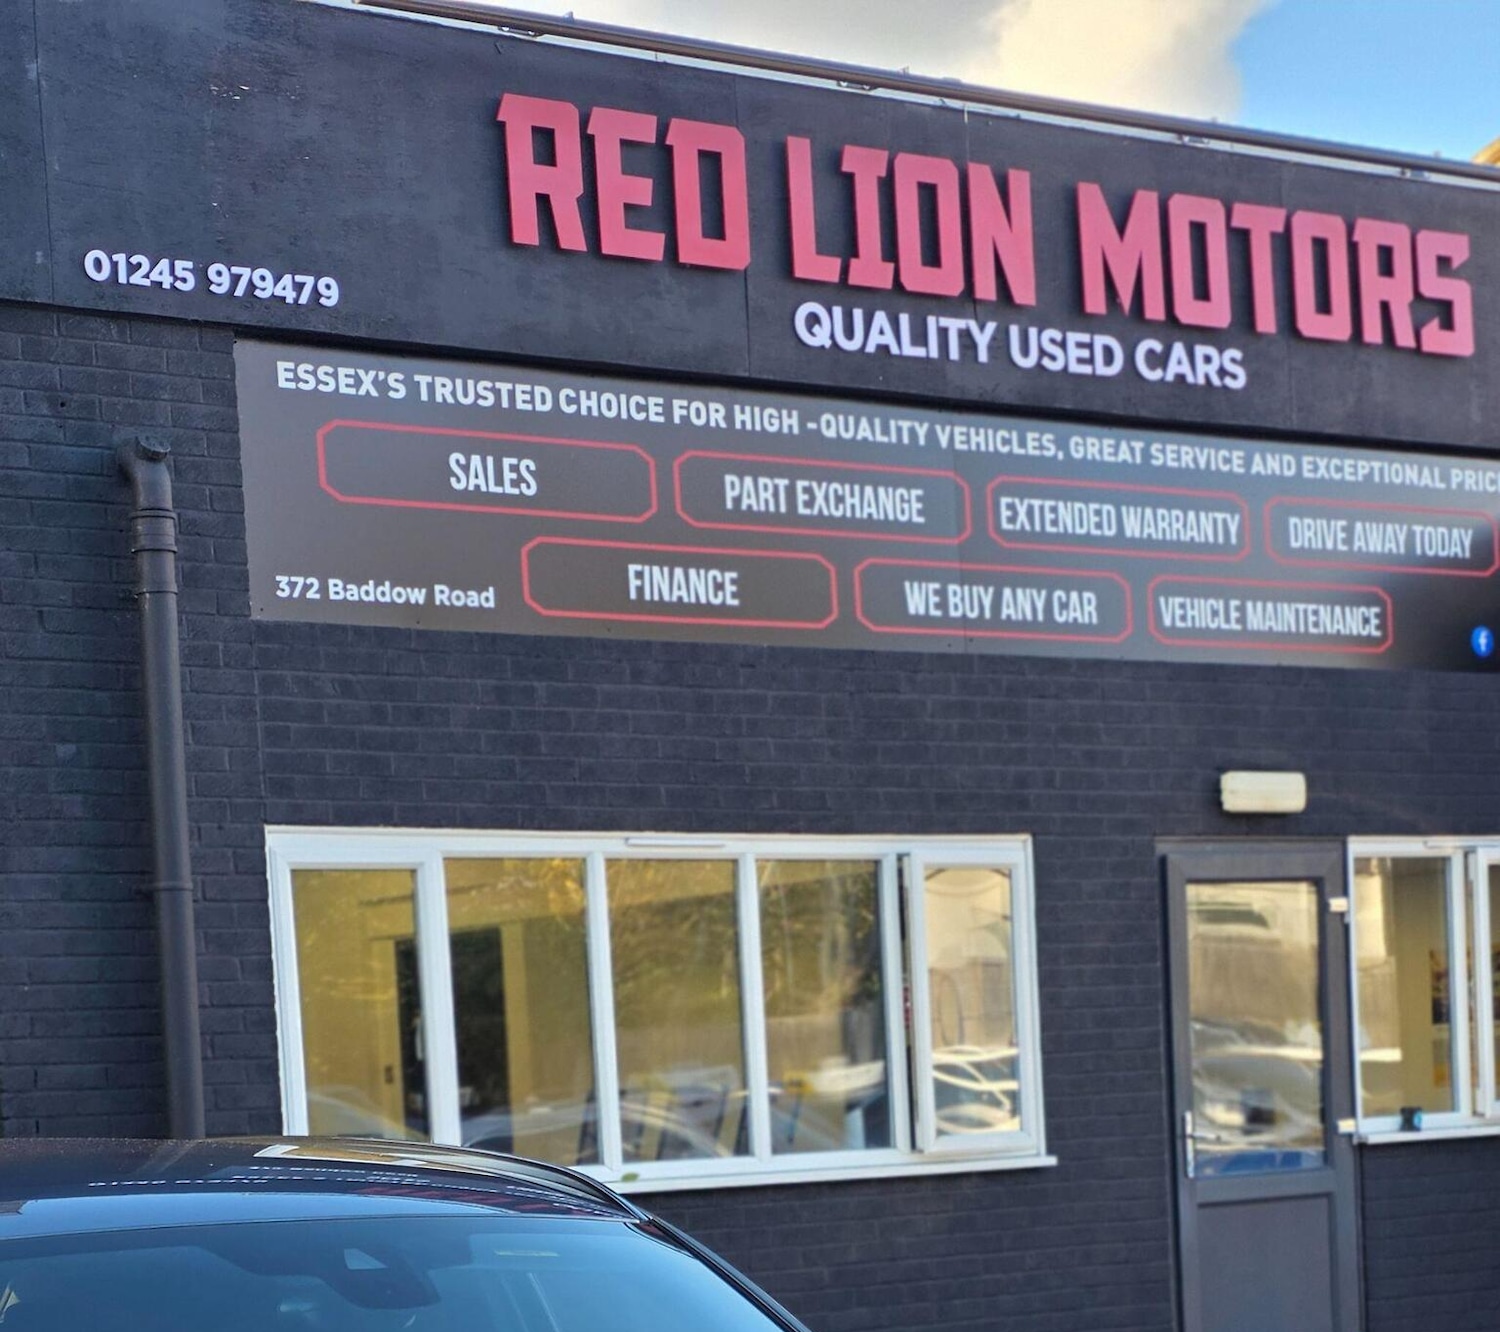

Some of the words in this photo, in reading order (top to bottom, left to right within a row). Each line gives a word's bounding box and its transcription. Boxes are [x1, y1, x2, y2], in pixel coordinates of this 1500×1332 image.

[497, 92, 750, 271] RED
[786, 135, 1036, 306] LION
[1077, 182, 1475, 357] MOTORS
[84, 249, 195, 292] 01245
[207, 261, 340, 307] 979479
[794, 302, 997, 363] QUALITY
[1010, 326, 1124, 378] USED
[1135, 339, 1247, 390] CARS
[276, 361, 407, 399] ESSEX'S
[414, 374, 552, 412] TRUSTED
[559, 388, 665, 423] CHOICE
[672, 399, 727, 428] FOR
[734, 404, 799, 435] HIGH
[935, 424, 1063, 460] VEHICLES,
[1069, 436, 1143, 464] GREAT
[1150, 443, 1245, 474] SERVICE
[1251, 452, 1296, 477] AND
[1302, 456, 1446, 488] EXCEPTIONAL
[1450, 467, 1500, 494] PRIC
[449, 452, 537, 496] SALES
[724, 474, 788, 513] PART
[796, 480, 925, 523] EXCHANGE
[1000, 496, 1117, 537] EXTENDED
[1121, 505, 1240, 545] WARRANTY
[1288, 516, 1348, 551] DRIVE
[1353, 521, 1408, 555] AWAY
[1412, 525, 1474, 559] TODAY
[275, 575, 320, 599] 372
[328, 578, 426, 605] Baddow
[434, 584, 495, 608] Road
[628, 564, 739, 606] FINANCE
[905, 581, 942, 616] WE
[947, 584, 993, 619] BUY
[1000, 587, 1046, 622] ANY
[1053, 590, 1097, 624] CAR
[1159, 596, 1242, 631] VEHICLE
[1246, 601, 1381, 637] MAINTENANCE
